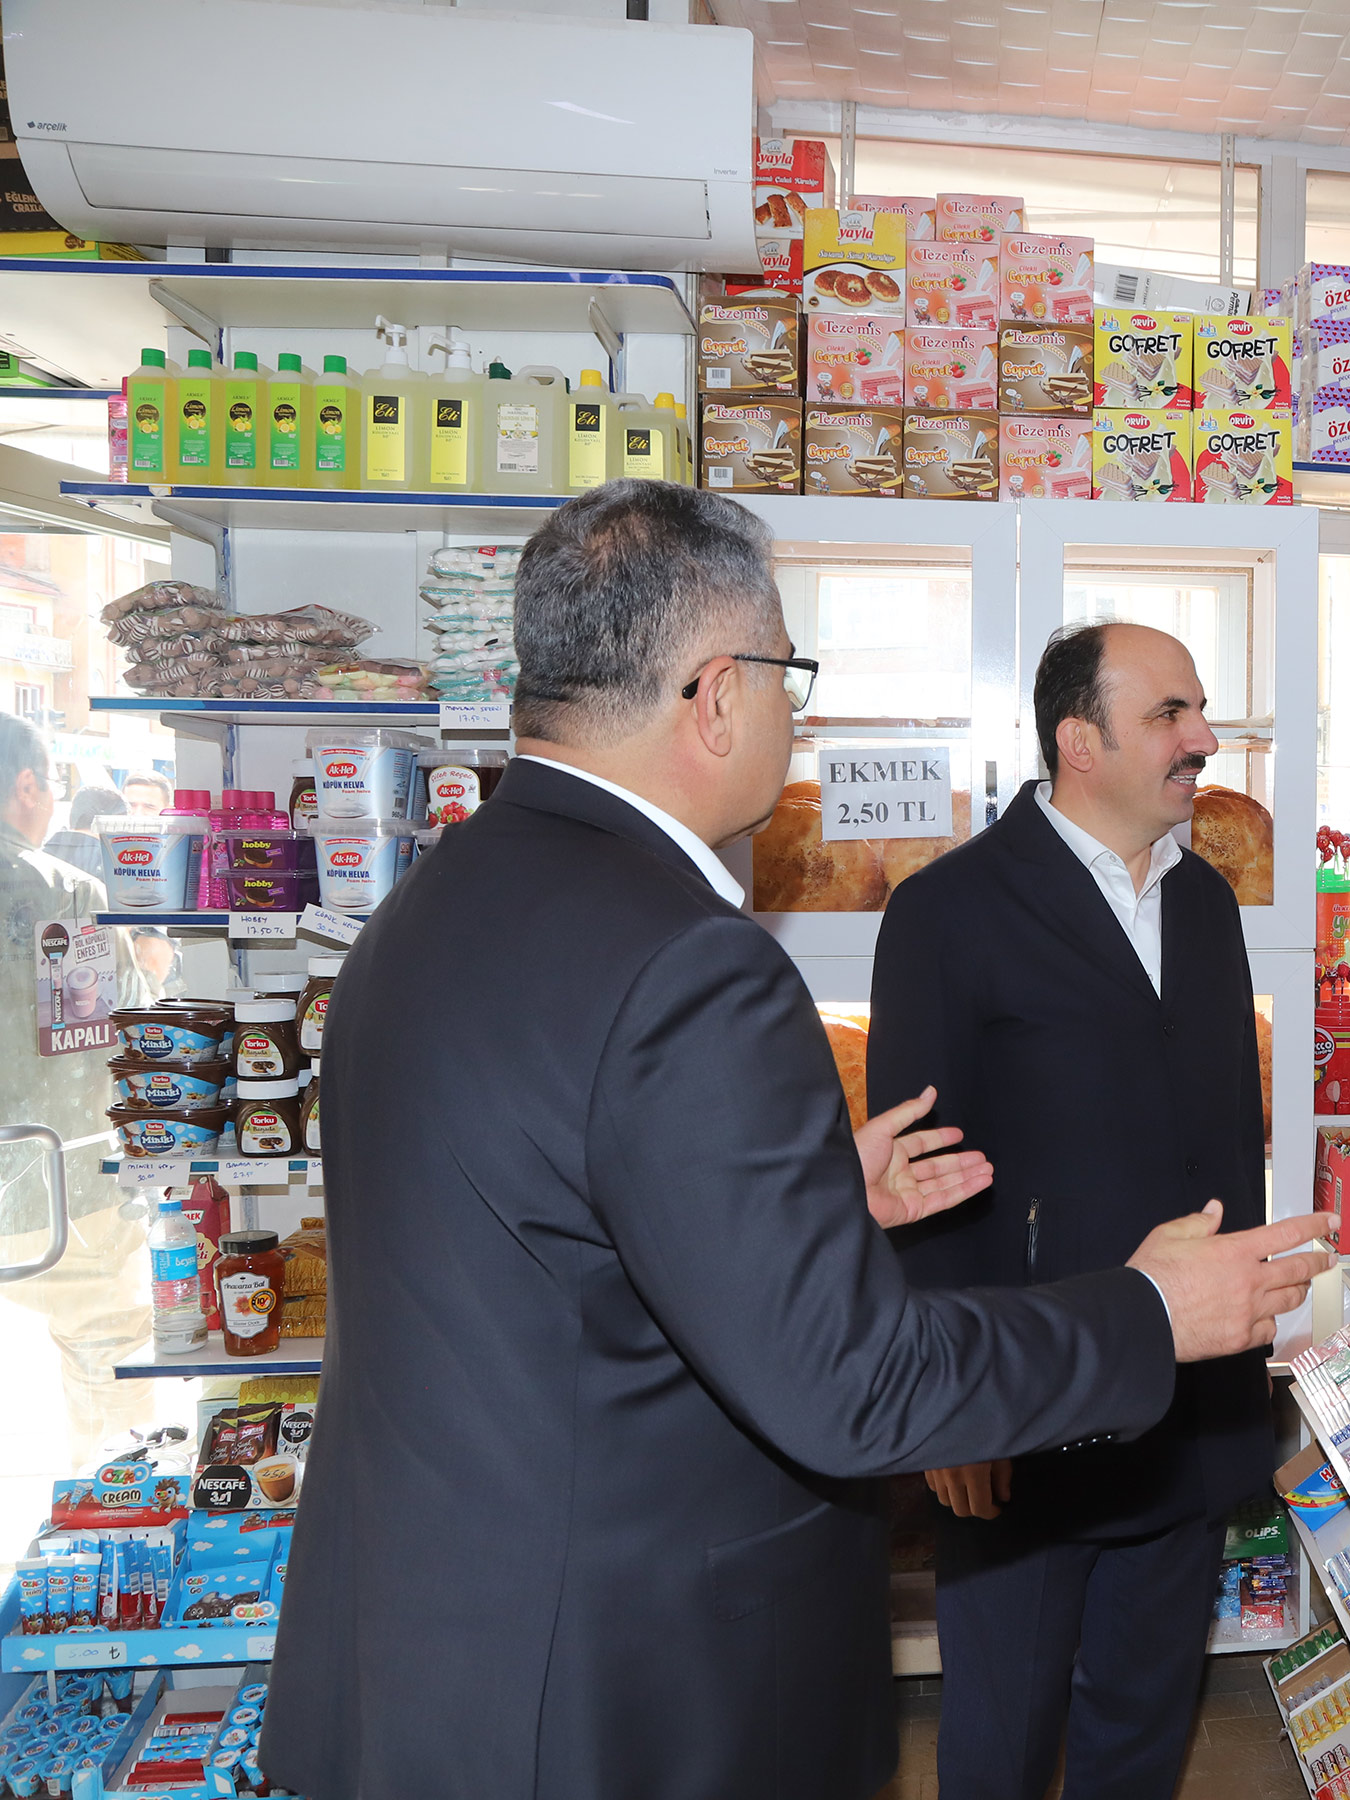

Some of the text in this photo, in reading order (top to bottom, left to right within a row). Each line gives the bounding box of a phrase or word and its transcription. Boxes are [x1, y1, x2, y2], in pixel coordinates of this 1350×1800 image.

[37, 121, 67, 132] arçelik
[757, 152, 794, 168] yayla
[952, 201, 1004, 215] Teze mis
[838, 227, 875, 242] yayla
[920, 248, 976, 263] Teze mis
[1016, 241, 1073, 257] Teze mis
[710, 305, 768, 321] Teze mis
[824, 320, 882, 336] Teze mis
[1009, 330, 1065, 345] Teze mis
[1109, 334, 1182, 355] GOFRET
[1207, 338, 1279, 360] GOFRET
[1103, 431, 1176, 455] GOFRET
[1208, 431, 1280, 454] GOFRET
[328, 764, 355, 776] Ak-Hel
[828, 760, 943, 785] EKMEK
[323, 779, 365, 790] KÖPÜK HELVA
[439, 785, 464, 796] Ak-Hel
[838, 801, 936, 826] 2,50 TL
[242, 841, 272, 850] hobby
[121, 852, 150, 864] Ak-Hel
[113, 867, 161, 877] KÖPÜK HELVA
[244, 880, 274, 889] hobby
[76, 942, 108, 961] ENFES TAT
[51, 1023, 110, 1052] KAPALI
[140, 1038, 173, 1049] Miniki
[244, 1040, 268, 1049] Torku
[147, 1087, 181, 1098] Miniki
[251, 1115, 276, 1125] Torku
[141, 1134, 175, 1145] Miniki
[101, 1467, 148, 1486] OZMO
[102, 1488, 142, 1505] CREAM
